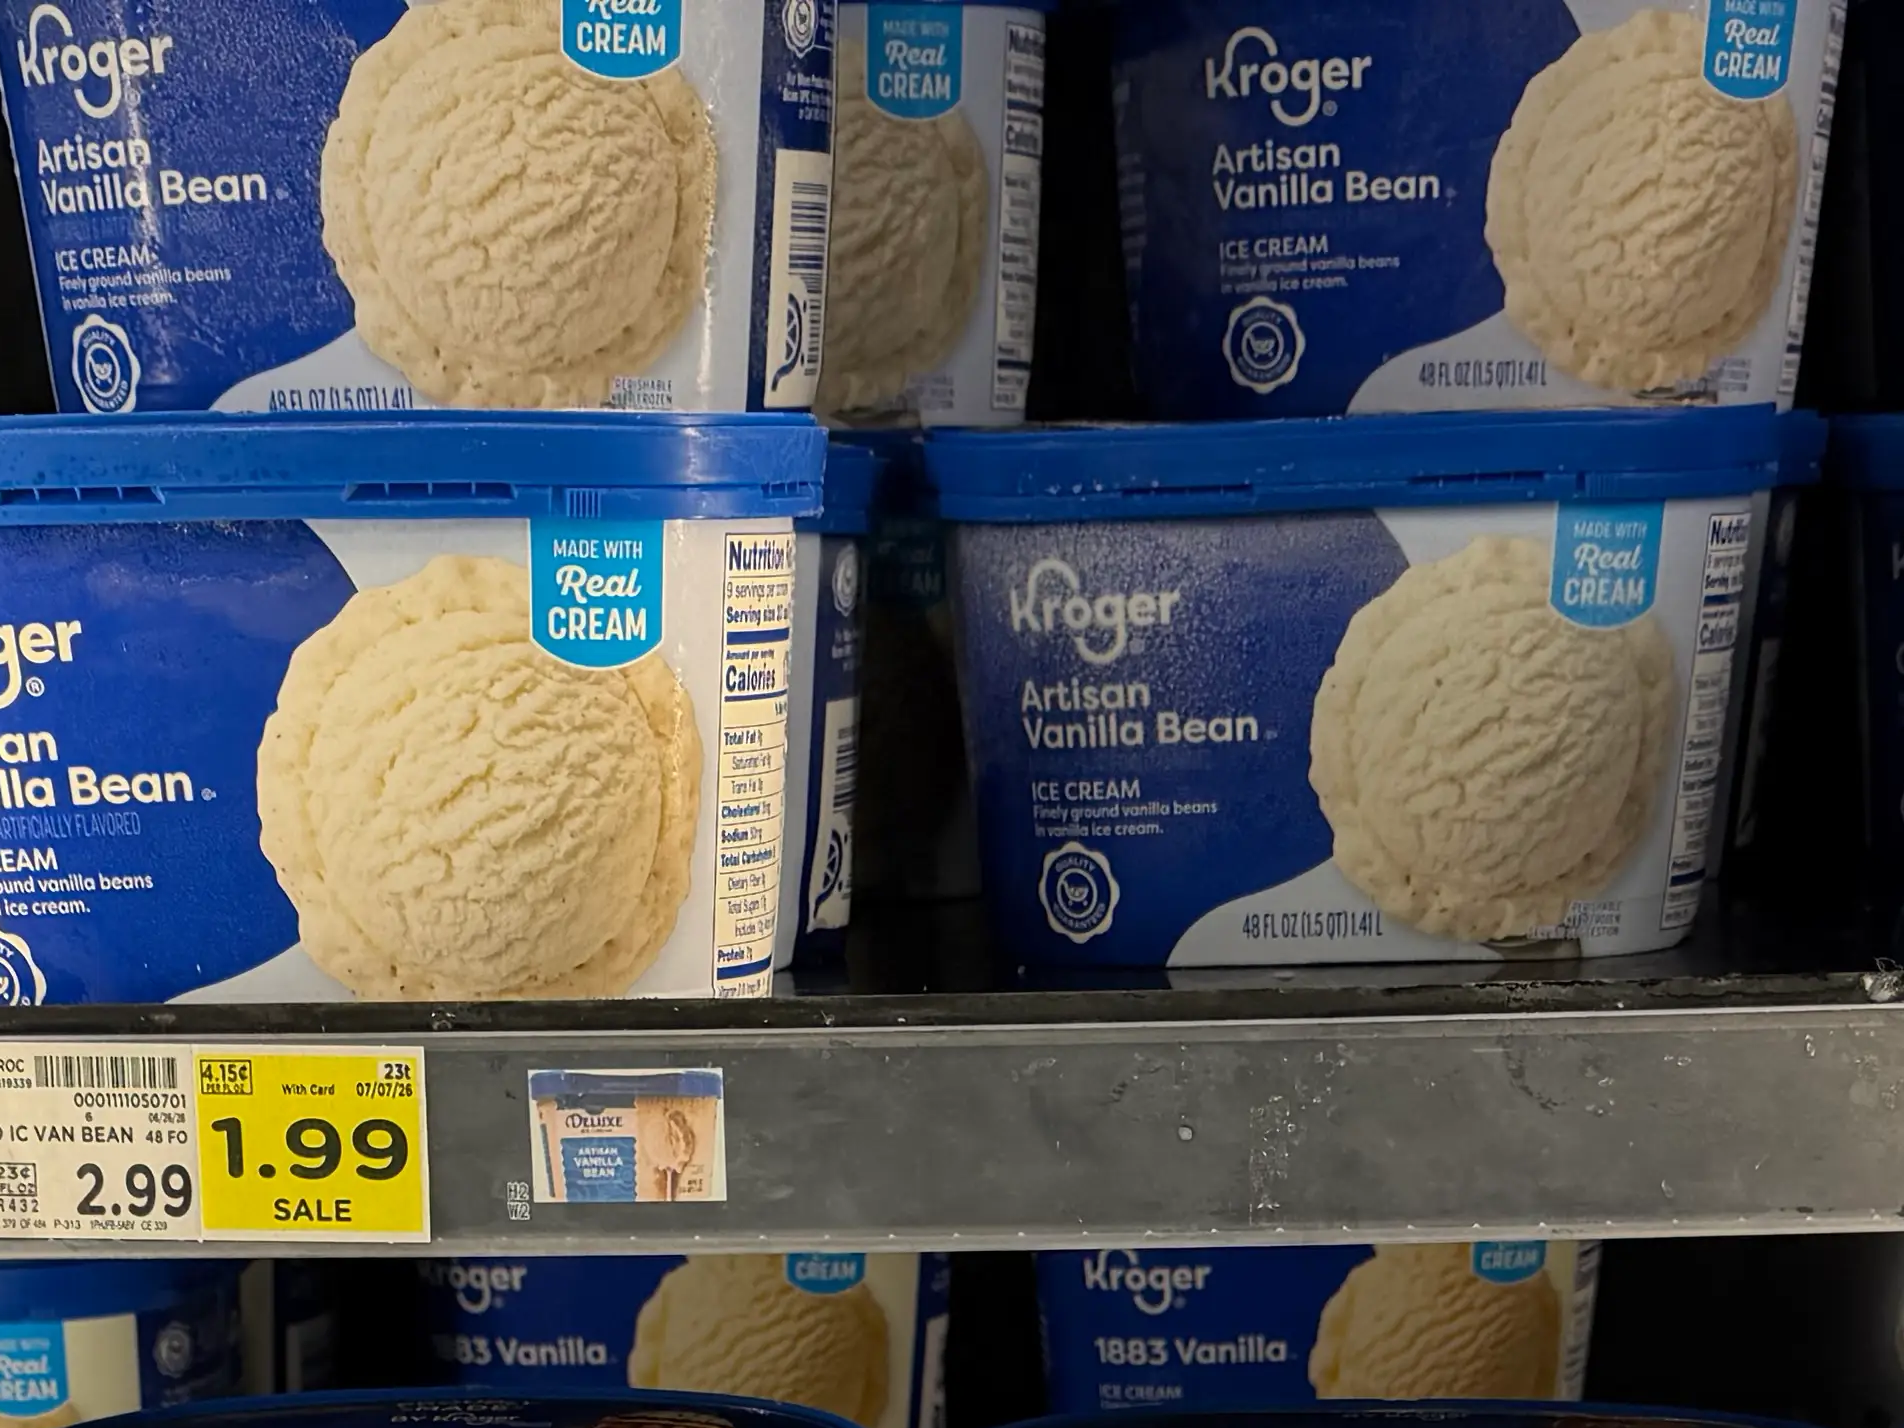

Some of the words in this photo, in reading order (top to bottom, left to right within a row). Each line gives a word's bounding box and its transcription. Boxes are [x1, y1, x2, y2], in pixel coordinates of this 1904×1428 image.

[18, 2, 173, 119] Kroger
[1205, 26, 1372, 127] Kroger
[553, 539, 601, 560] MADE
[605, 538, 644, 558] WITH
[1009, 558, 1181, 665] Kroger
[547, 605, 648, 643] CREAM
[1021, 678, 1151, 714] Artisan
[1022, 711, 1147, 750] Vanilla
[1156, 710, 1259, 745] Bean
[69, 765, 194, 807] Bean
[38, 874, 95, 893] vanilla
[99, 872, 153, 891] beans
[8, 897, 33, 916] ice
[37, 895, 91, 915] cream.
[384, 1063, 411, 1080] 23t
[74, 1094, 186, 1109] 0001111050701
[356, 1083, 413, 1098] 07/07/26
[10, 1126, 30, 1143] IC
[35, 1126, 74, 1143] VAN
[83, 1127, 133, 1143] BEAN
[211, 1117, 408, 1180] 1.99
[573, 1158, 623, 1166] VANILLA
[583, 1168, 614, 1177] BEAN
[76, 1163, 192, 1217] 2.99
[274, 1199, 352, 1222] SALE
